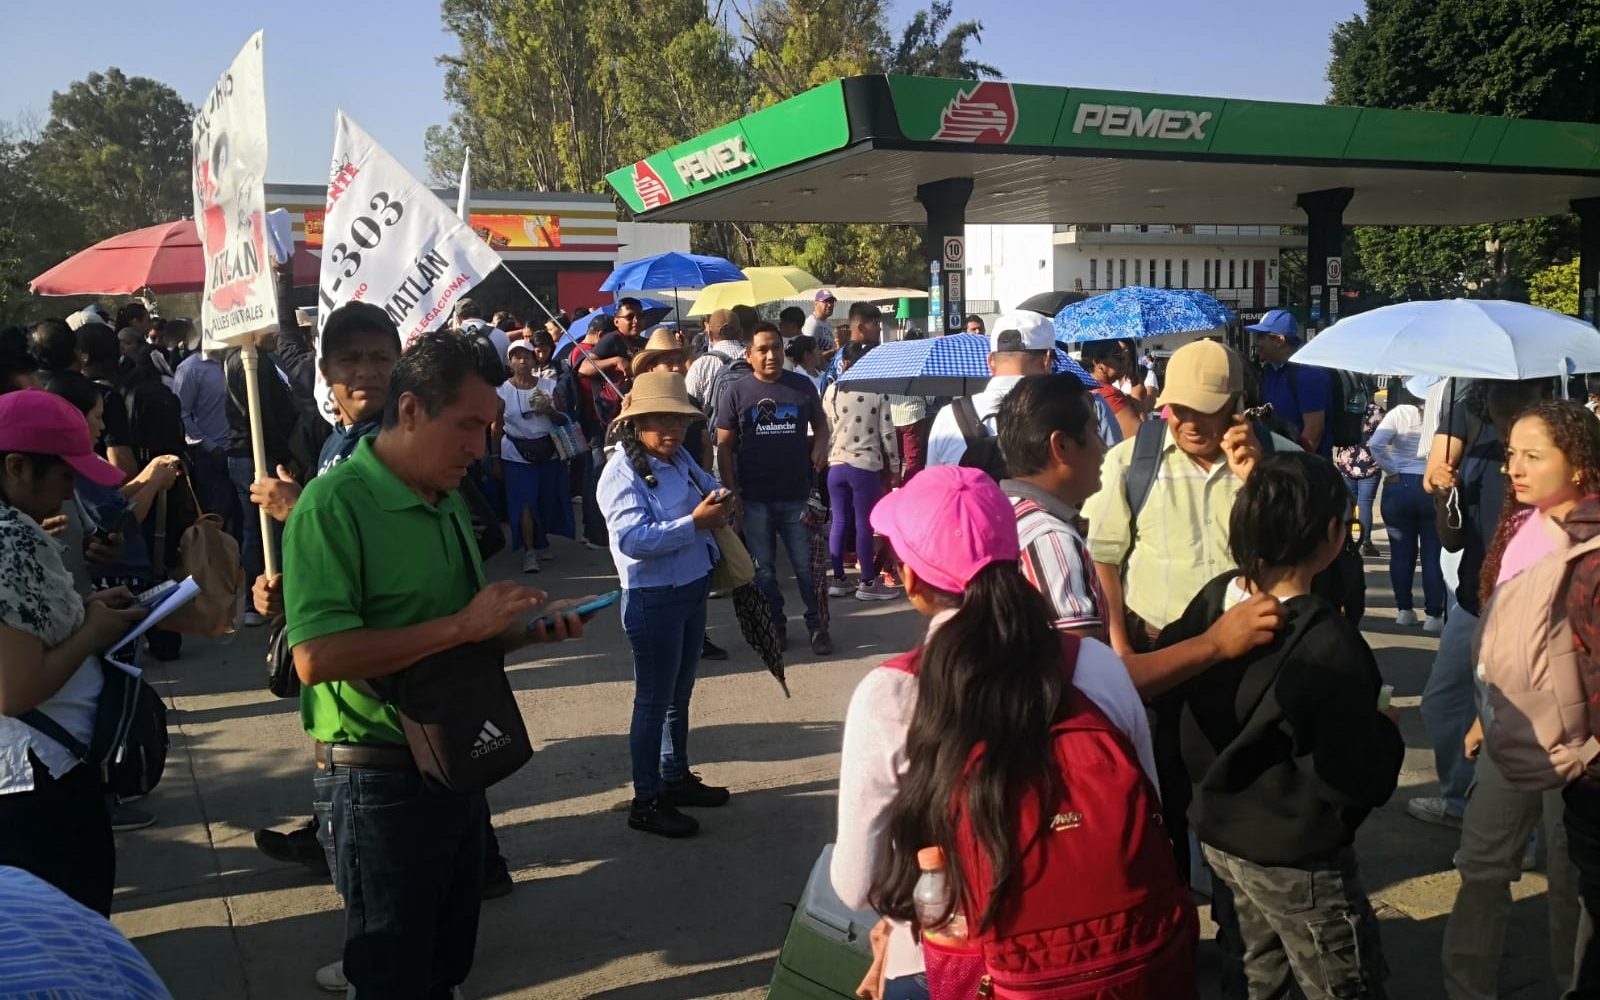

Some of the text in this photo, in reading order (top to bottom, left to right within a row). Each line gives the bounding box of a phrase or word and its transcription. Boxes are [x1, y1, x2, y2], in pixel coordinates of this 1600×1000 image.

[1072, 103, 1213, 140] PEMEX
[673, 134, 757, 186] PEMEX
[949, 243, 960, 256] 10
[1240, 312, 1265, 321] PEME
[755, 420, 797, 432] Avalanche
[470, 734, 512, 759] adidas
